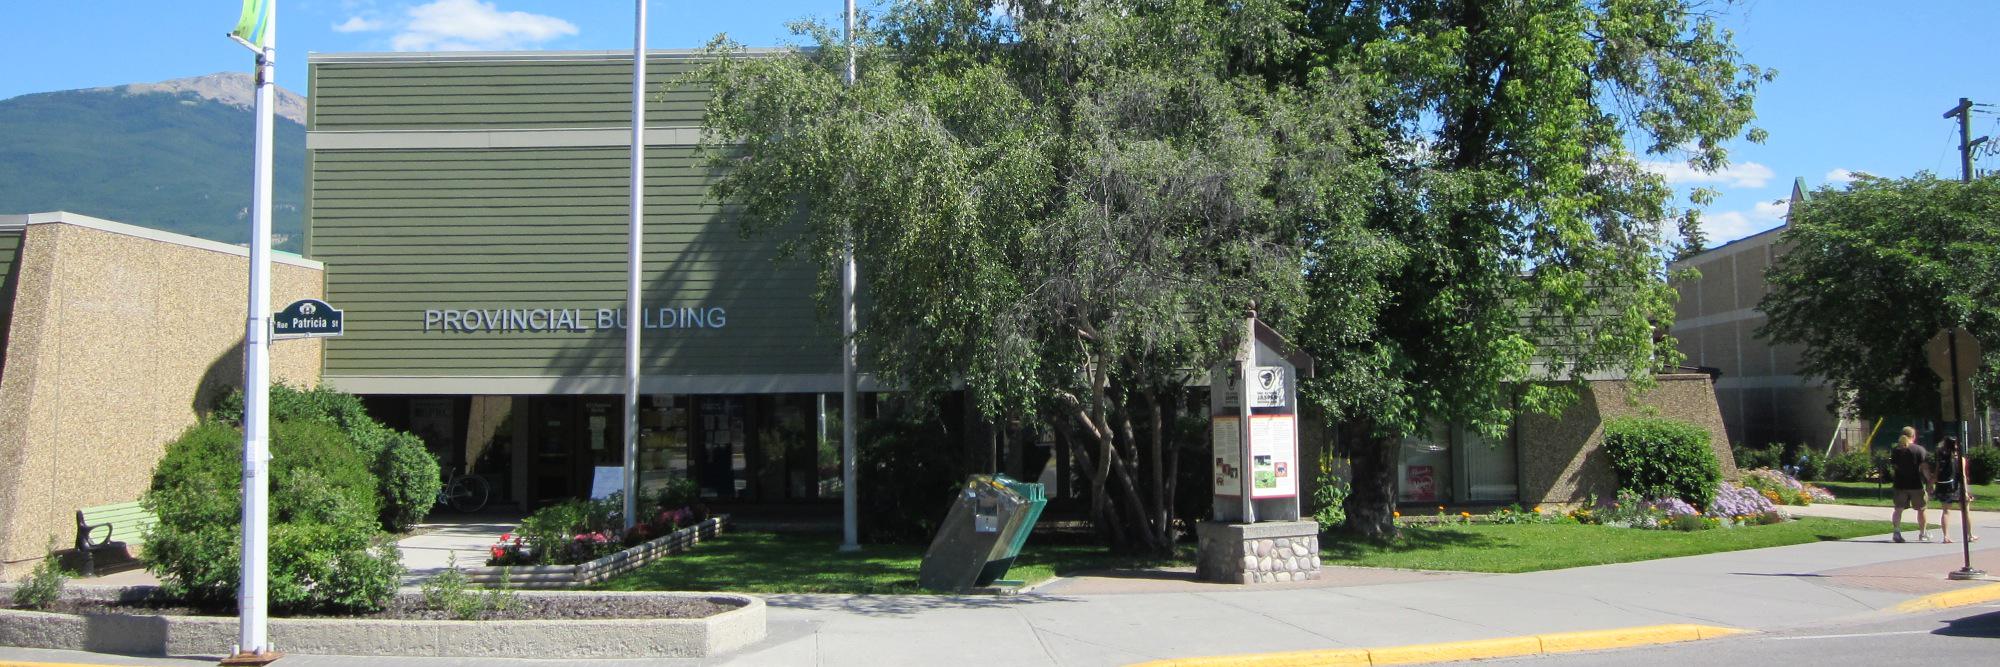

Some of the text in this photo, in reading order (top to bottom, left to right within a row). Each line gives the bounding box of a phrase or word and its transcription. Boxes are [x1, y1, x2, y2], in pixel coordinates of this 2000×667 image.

[276, 317, 339, 329] Rue Patricia St
[424, 306, 727, 331] PROVINCIAL BULDING
